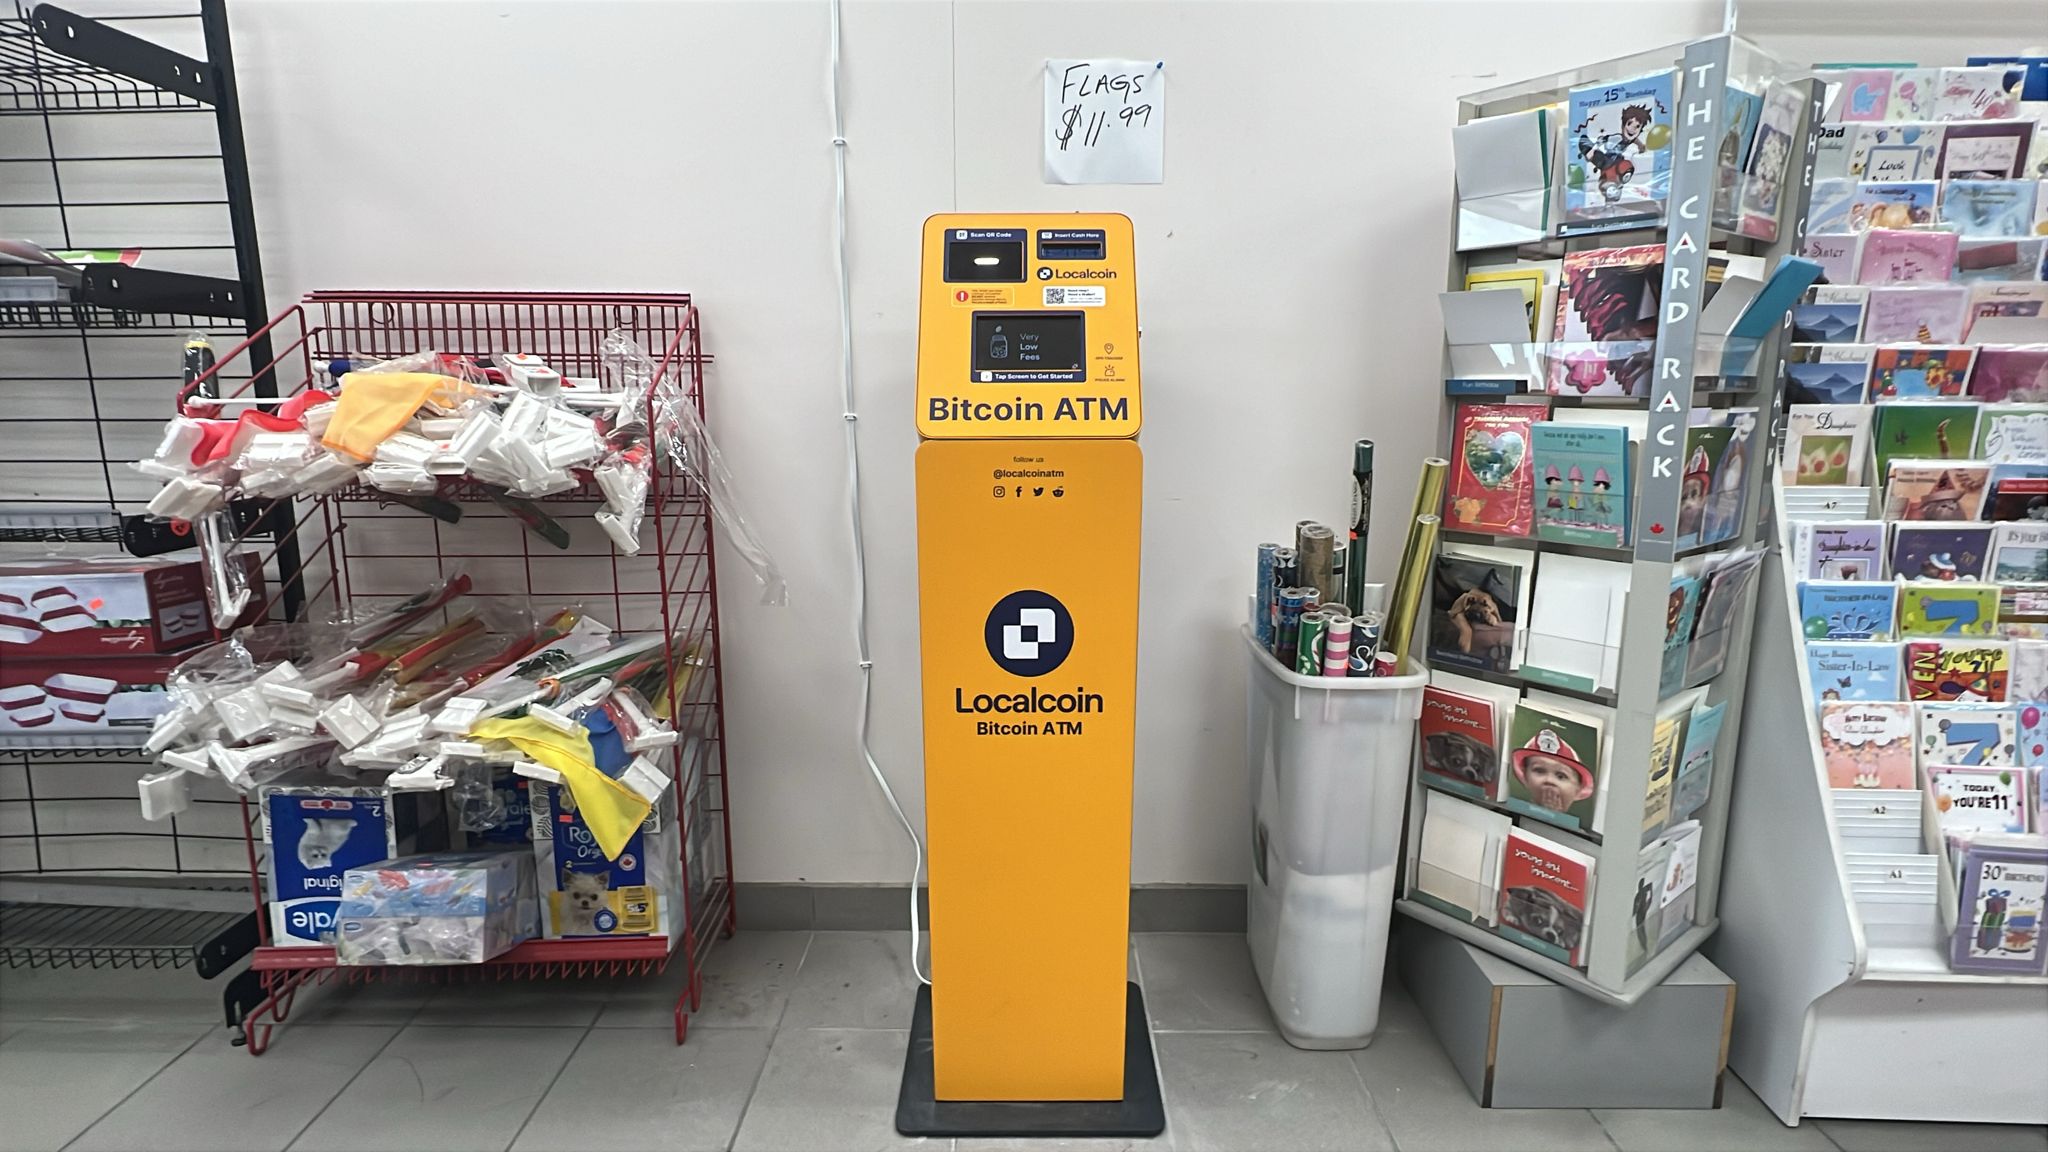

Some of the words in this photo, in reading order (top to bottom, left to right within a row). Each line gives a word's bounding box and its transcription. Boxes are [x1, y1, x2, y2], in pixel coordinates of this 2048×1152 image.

[1061, 63, 1144, 104] FLAGS
[1686, 63, 1716, 162] THE
[1055, 104, 1152, 151] $11.99
[1803, 100, 1822, 187] THE
[1812, 241, 1845, 258] Sister
[1666, 195, 1699, 324] CARD
[1055, 268, 1117, 280] Localcoin
[1020, 333, 1039, 341] Very
[1020, 343, 1039, 351] Low
[1020, 353, 1040, 361] Fees
[929, 396, 1043, 421] Bitcoin
[1053, 397, 1128, 421] ATM
[1652, 357, 1682, 478] RACK
[993, 469, 1064, 480] @localcoinatm
[1911, 651, 1937, 700] VEN
[955, 686, 1104, 713] Localcoin
[976, 721, 1038, 735] Bitcoin
[1042, 721, 1082, 735] ATM
[1963, 784, 1996, 793] TODAY
[1953, 797, 1991, 809] YOU'RE
[1991, 795, 2009, 809] 11
[1871, 806, 1887, 815] A2
[1889, 870, 1903, 879] A1
[304, 876, 343, 892] iginal
